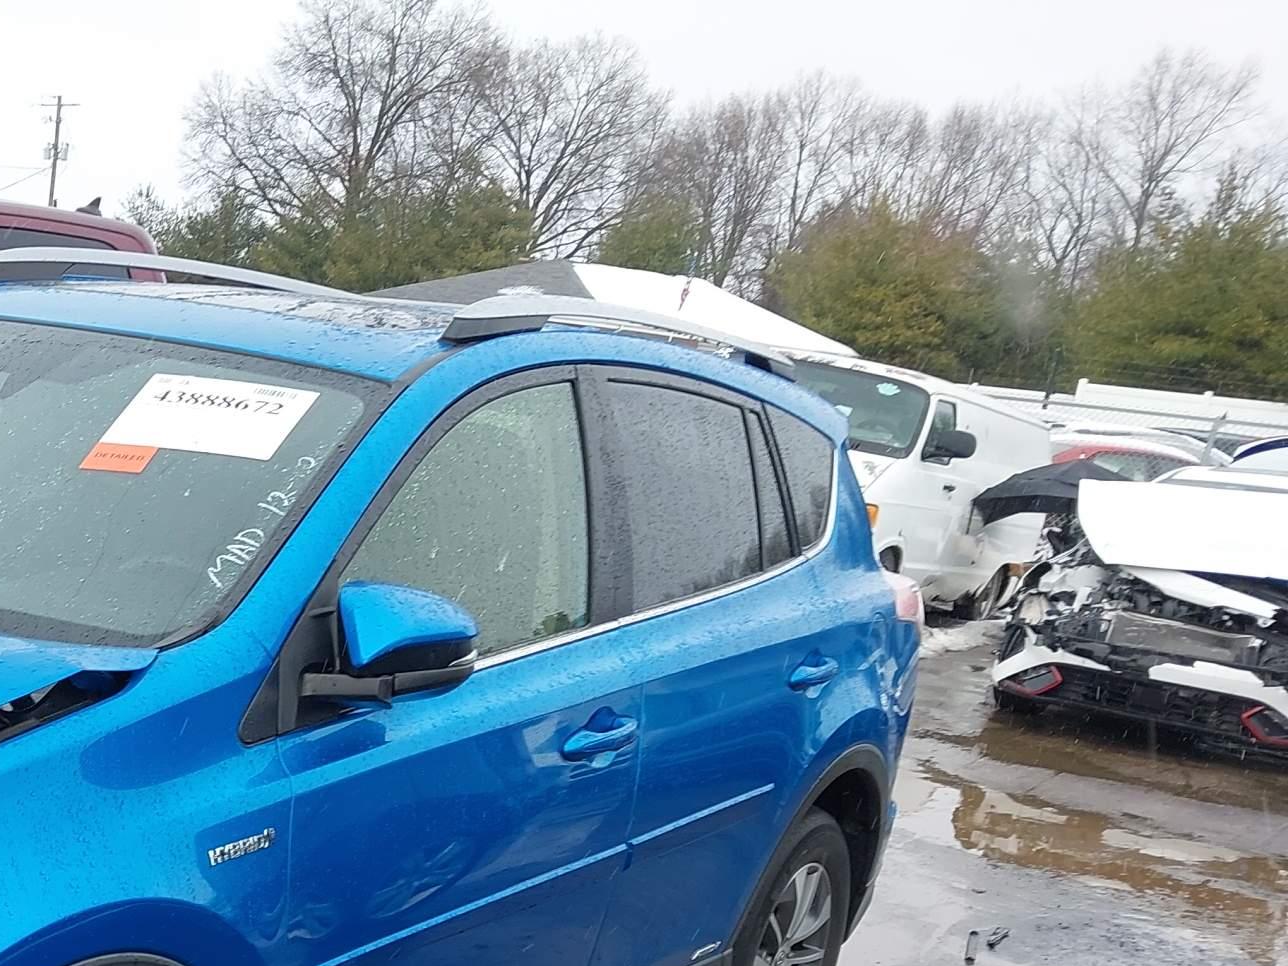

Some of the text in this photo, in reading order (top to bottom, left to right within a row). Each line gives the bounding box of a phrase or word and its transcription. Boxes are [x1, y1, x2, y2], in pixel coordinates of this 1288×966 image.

[153, 389, 285, 415] 43888672
[208, 528, 264, 588] MAD
[208, 827, 276, 867] HYBRID
